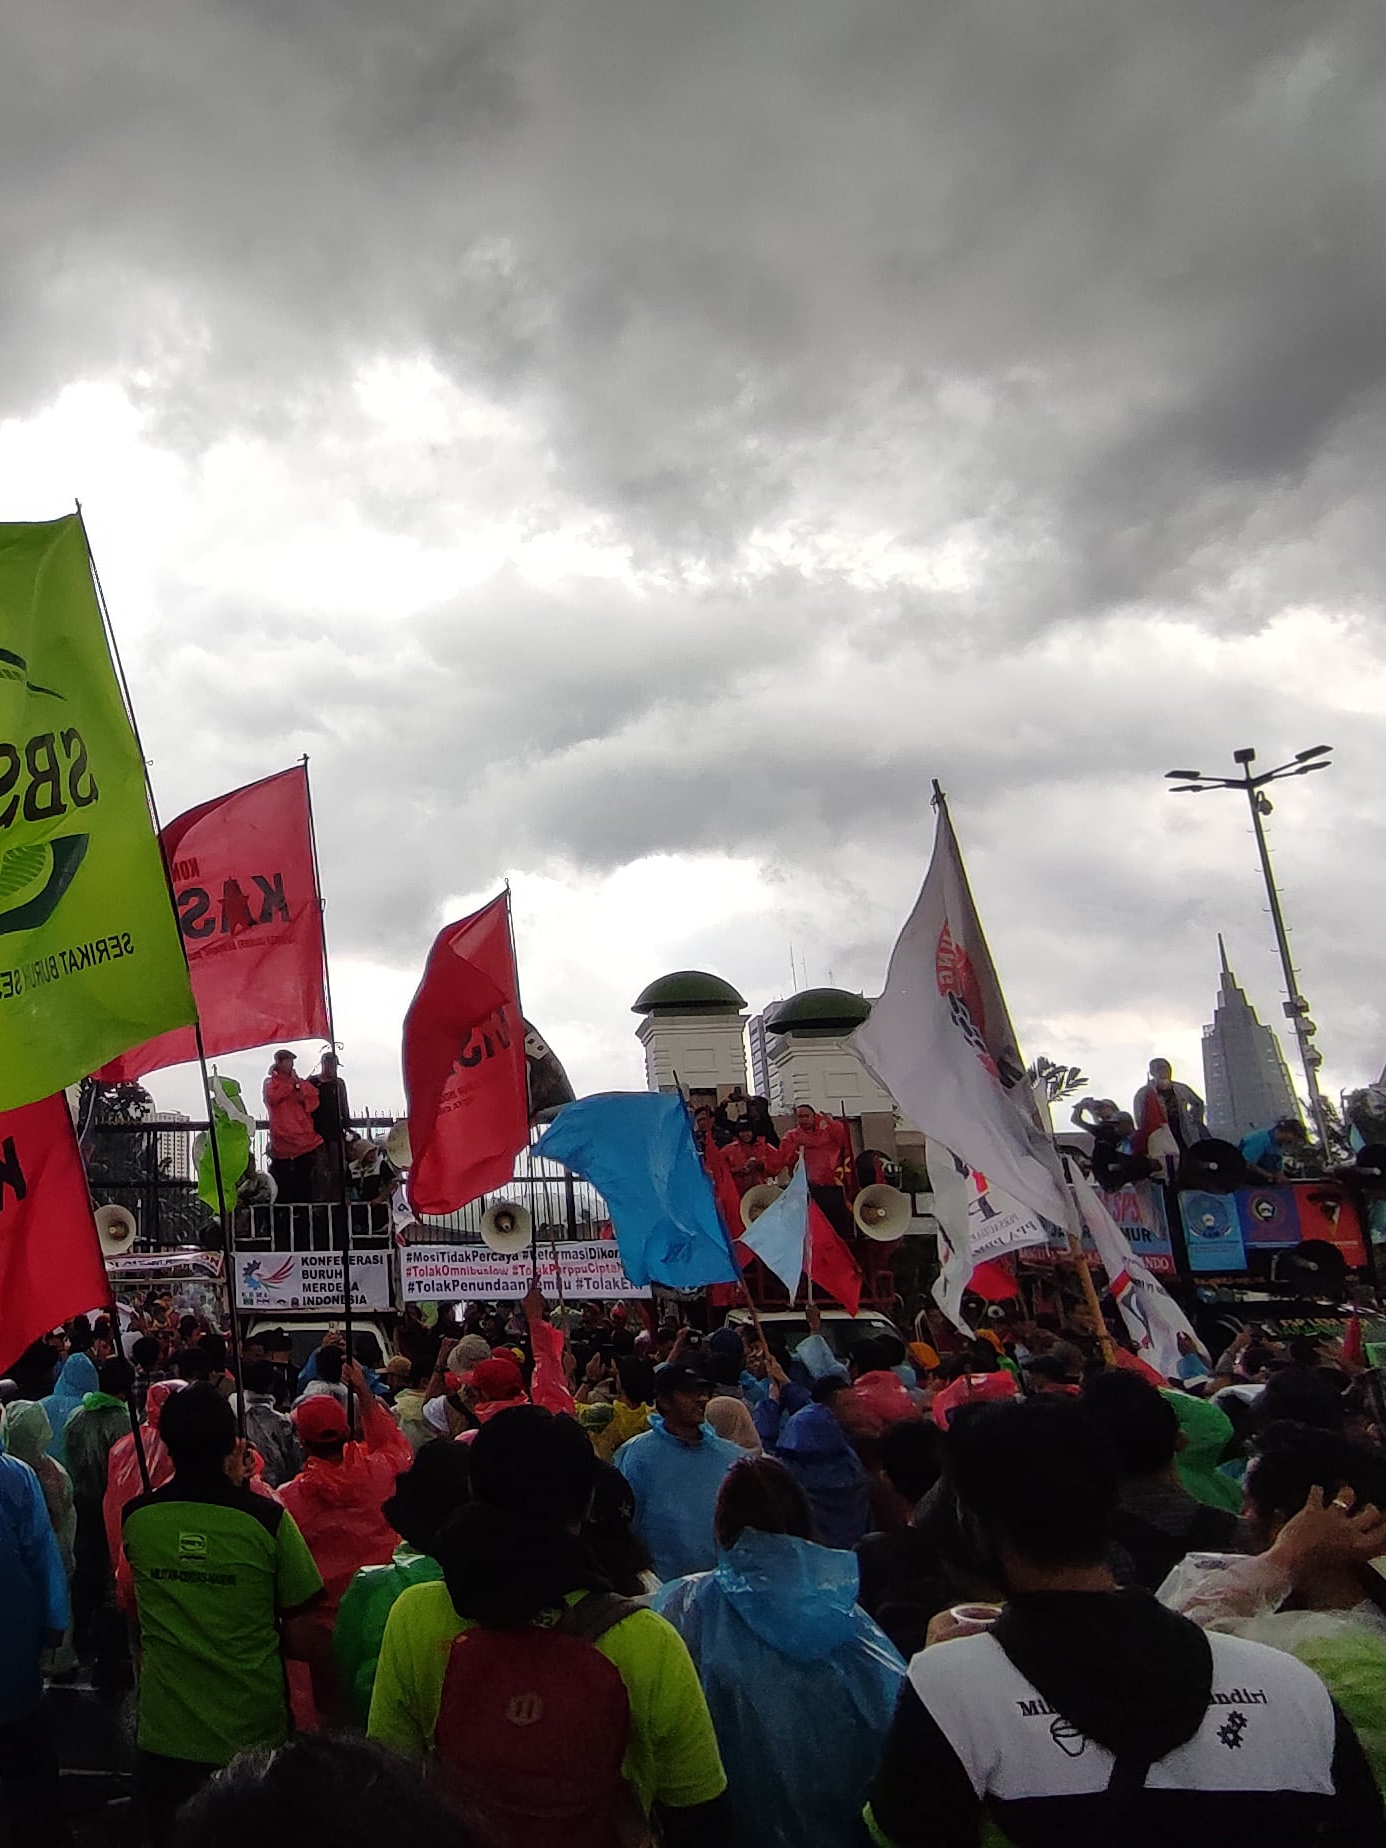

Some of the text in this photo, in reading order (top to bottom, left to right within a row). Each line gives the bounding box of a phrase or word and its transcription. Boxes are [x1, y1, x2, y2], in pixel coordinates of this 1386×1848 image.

[405, 1247, 619, 1265] #MosiTidakPercaya #eformasiDikor
[301, 1268, 343, 1280] BURUH
[301, 1281, 360, 1293] MERDEA
[302, 1294, 368, 1306] INDONESIA
[1208, 1688, 1268, 1705] ndiri
